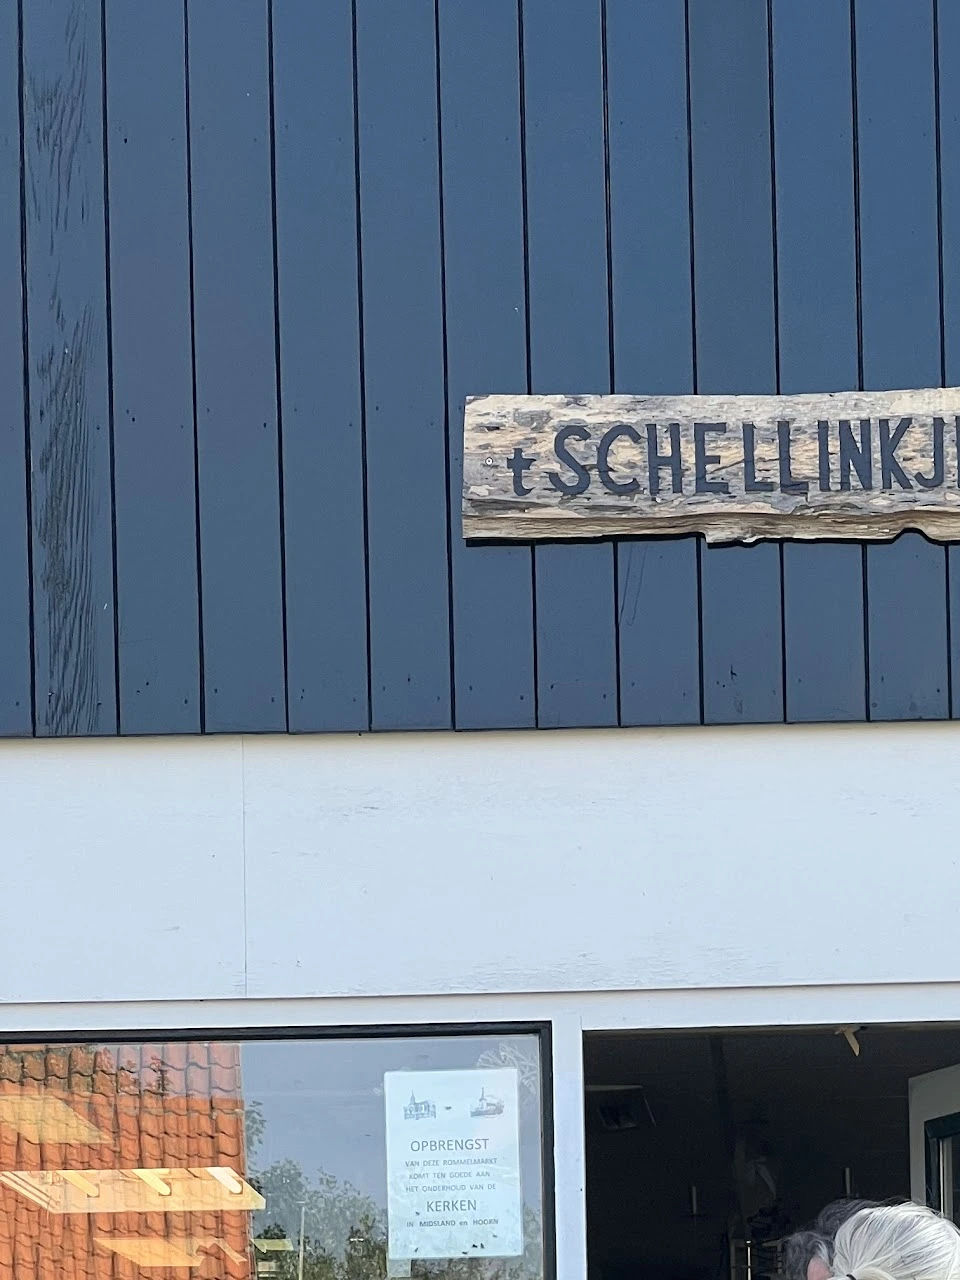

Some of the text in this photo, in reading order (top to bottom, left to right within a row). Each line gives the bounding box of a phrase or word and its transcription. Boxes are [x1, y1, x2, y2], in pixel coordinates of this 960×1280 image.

[410, 1138, 489, 1152] OPBRENGST
[405, 1157, 498, 1168] VAN DEZE ROMMELMARKT
[409, 1172, 429, 1180] KOMT
[449, 1171, 472, 1179] GOEDE
[405, 1185, 418, 1193] HET
[422, 1184, 467, 1193] ONDERHOUD
[470, 1183, 484, 1191] VAN
[426, 1199, 477, 1212] KERKEN
[406, 1220, 414, 1228] IN
[419, 1219, 456, 1228] MIDSLAND
[472, 1218, 499, 1226] HOORN
